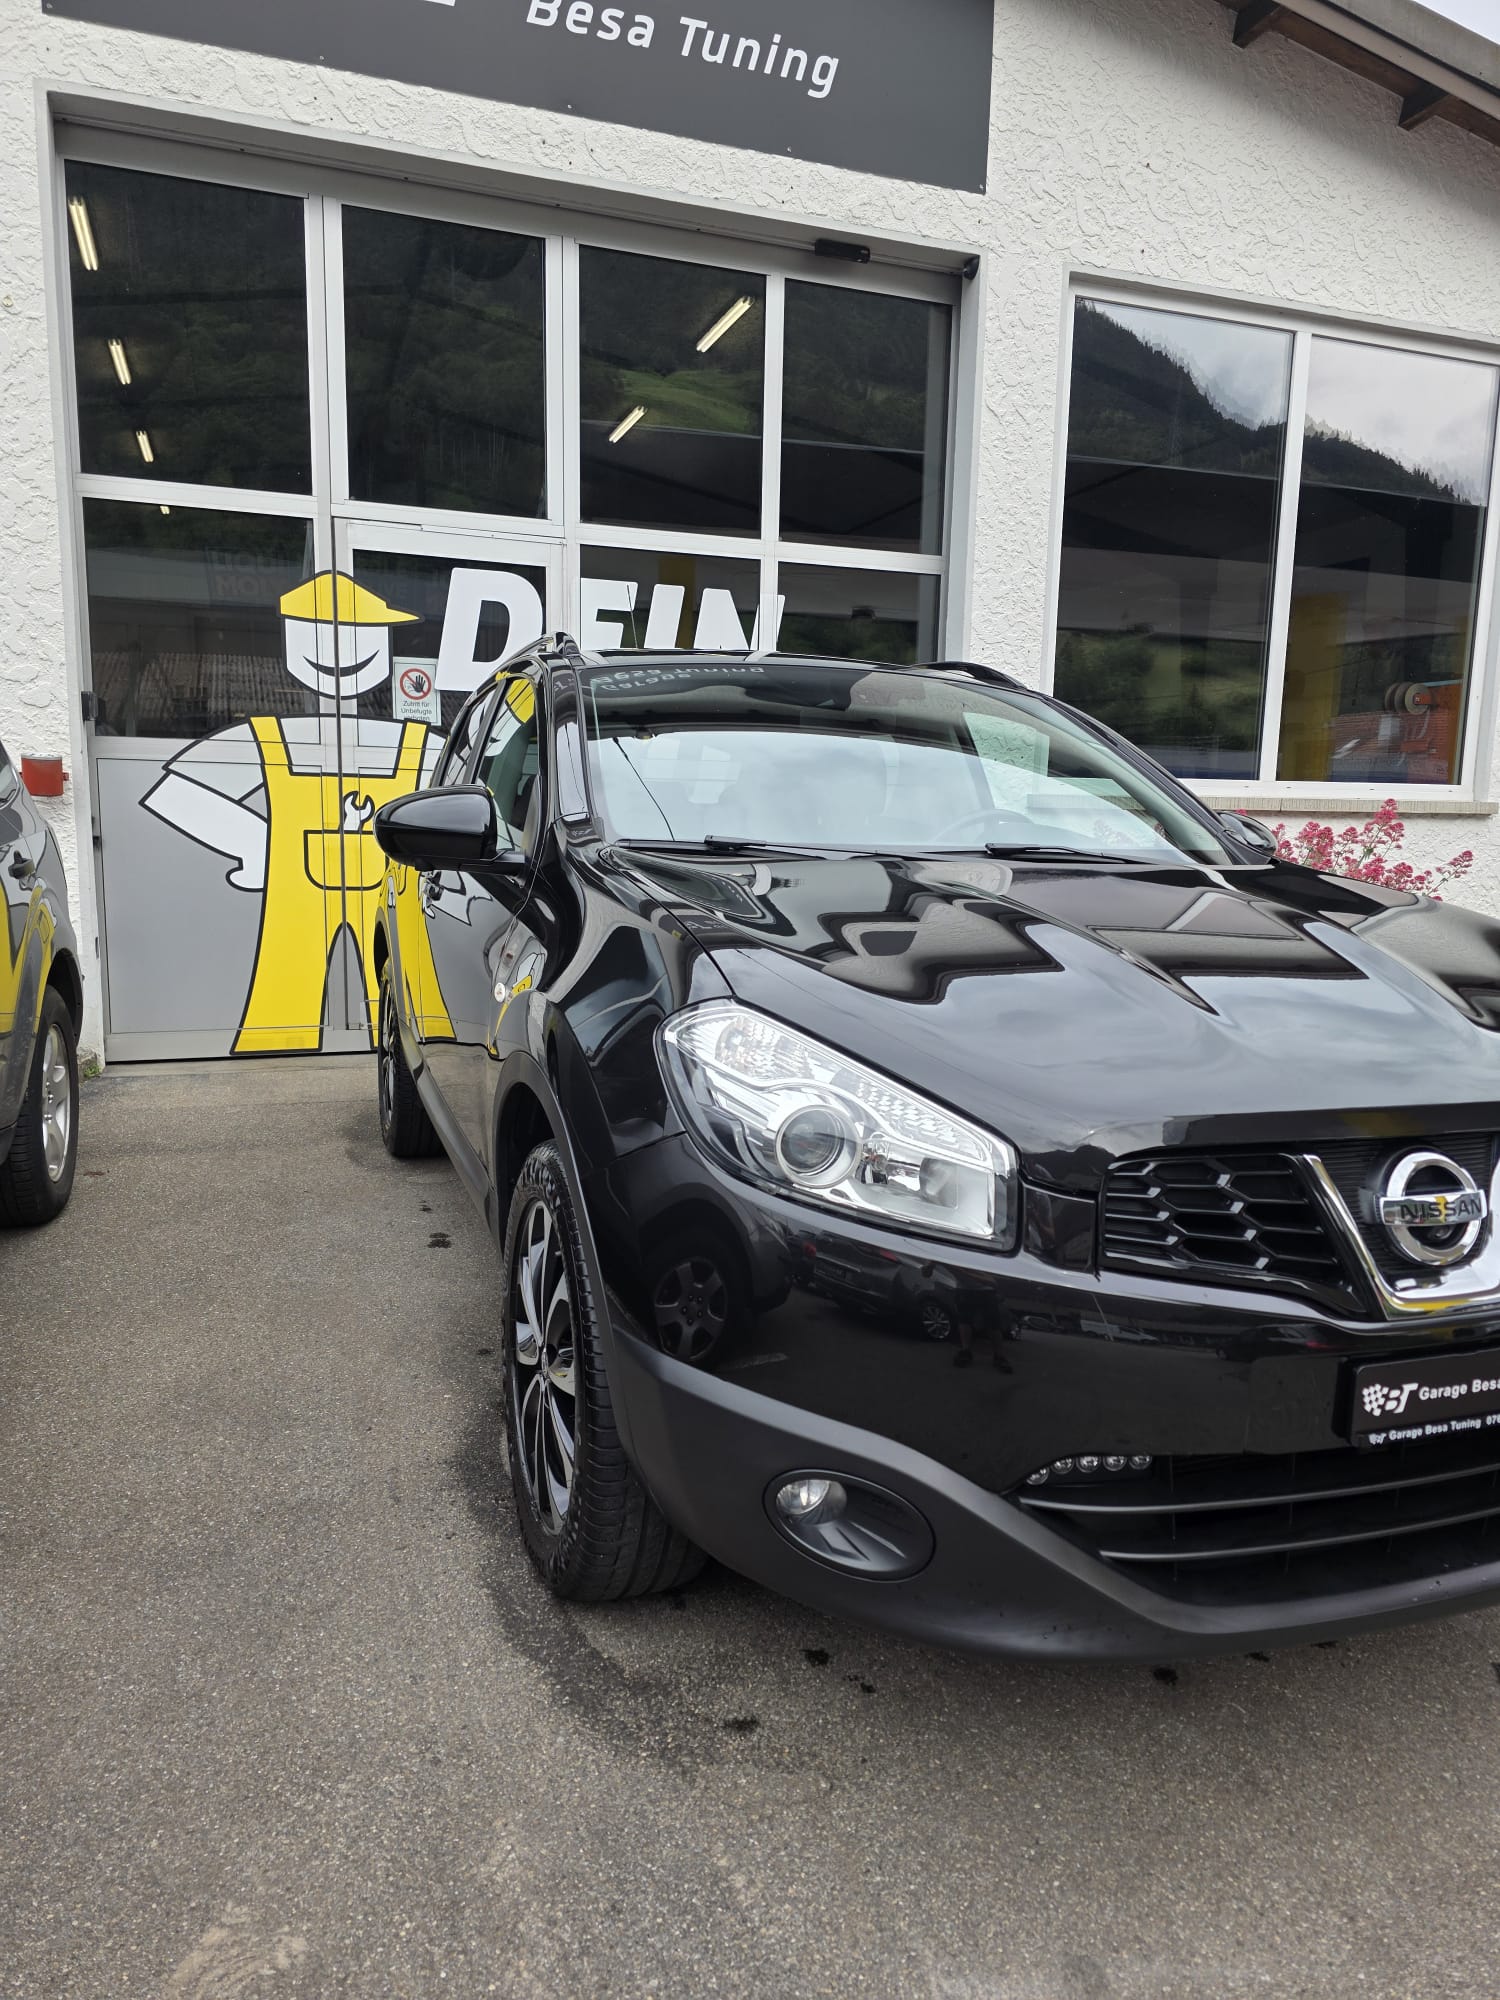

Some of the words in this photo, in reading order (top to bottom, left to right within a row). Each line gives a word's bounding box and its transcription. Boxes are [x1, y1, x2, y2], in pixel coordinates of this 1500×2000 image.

[526, 0, 655, 48] Besa
[679, 17, 839, 99] Tuning
[401, 707, 432, 716] Unbefugte
[1400, 1197, 1482, 1219] NISSAN
[1419, 1384, 1468, 1400] Garage
[1388, 1427, 1423, 1441] Garage
[1425, 1424, 1448, 1435] Besa
[1450, 1418, 1481, 1431] Tuning
